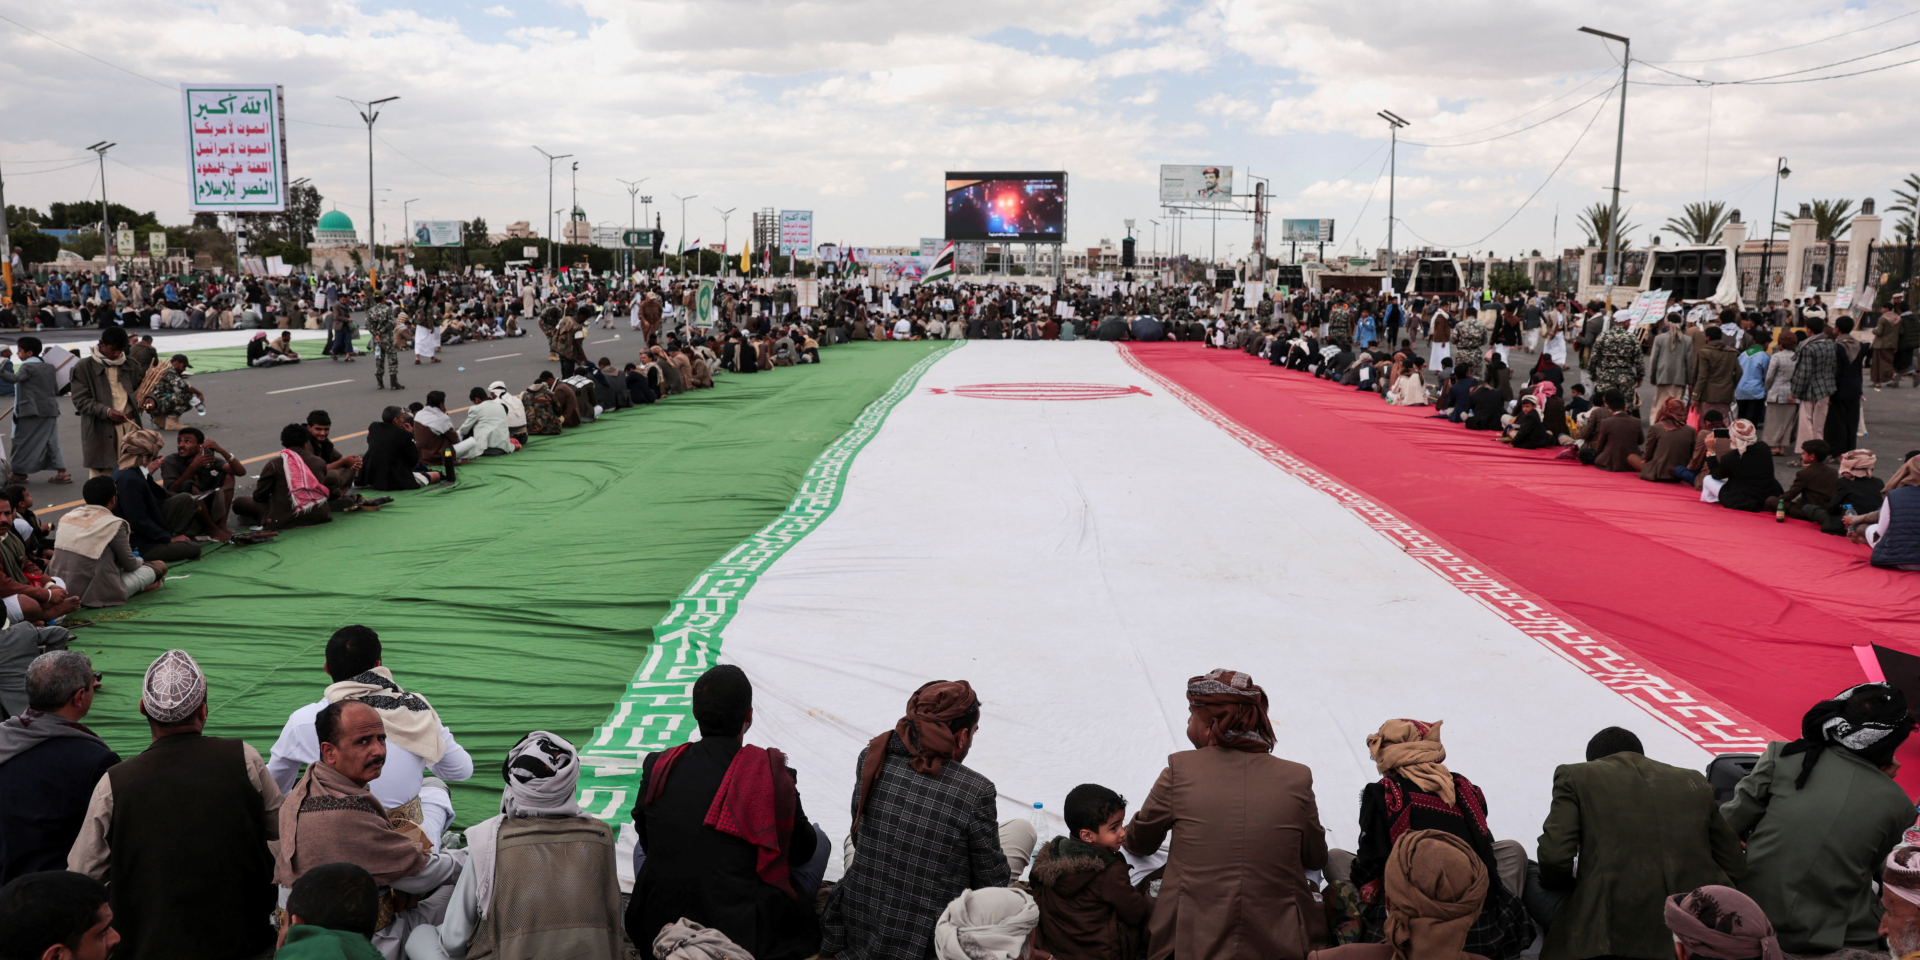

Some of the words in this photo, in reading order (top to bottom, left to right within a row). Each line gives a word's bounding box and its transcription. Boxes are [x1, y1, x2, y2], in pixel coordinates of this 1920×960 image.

[193, 93, 237, 120] أكبر
[240, 95, 268, 114] الله
[194, 119, 234, 137] لأمريكا
[237, 122, 269, 137] الموت
[196, 141, 235, 157] لإسرائيل
[238, 142, 271, 157] الموت
[197, 161, 225, 176] اليهود
[228, 162, 243, 177] على
[247, 161, 272, 174] اللعنة
[199, 180, 236, 201] للإسلام
[240, 178, 273, 200] النصر
